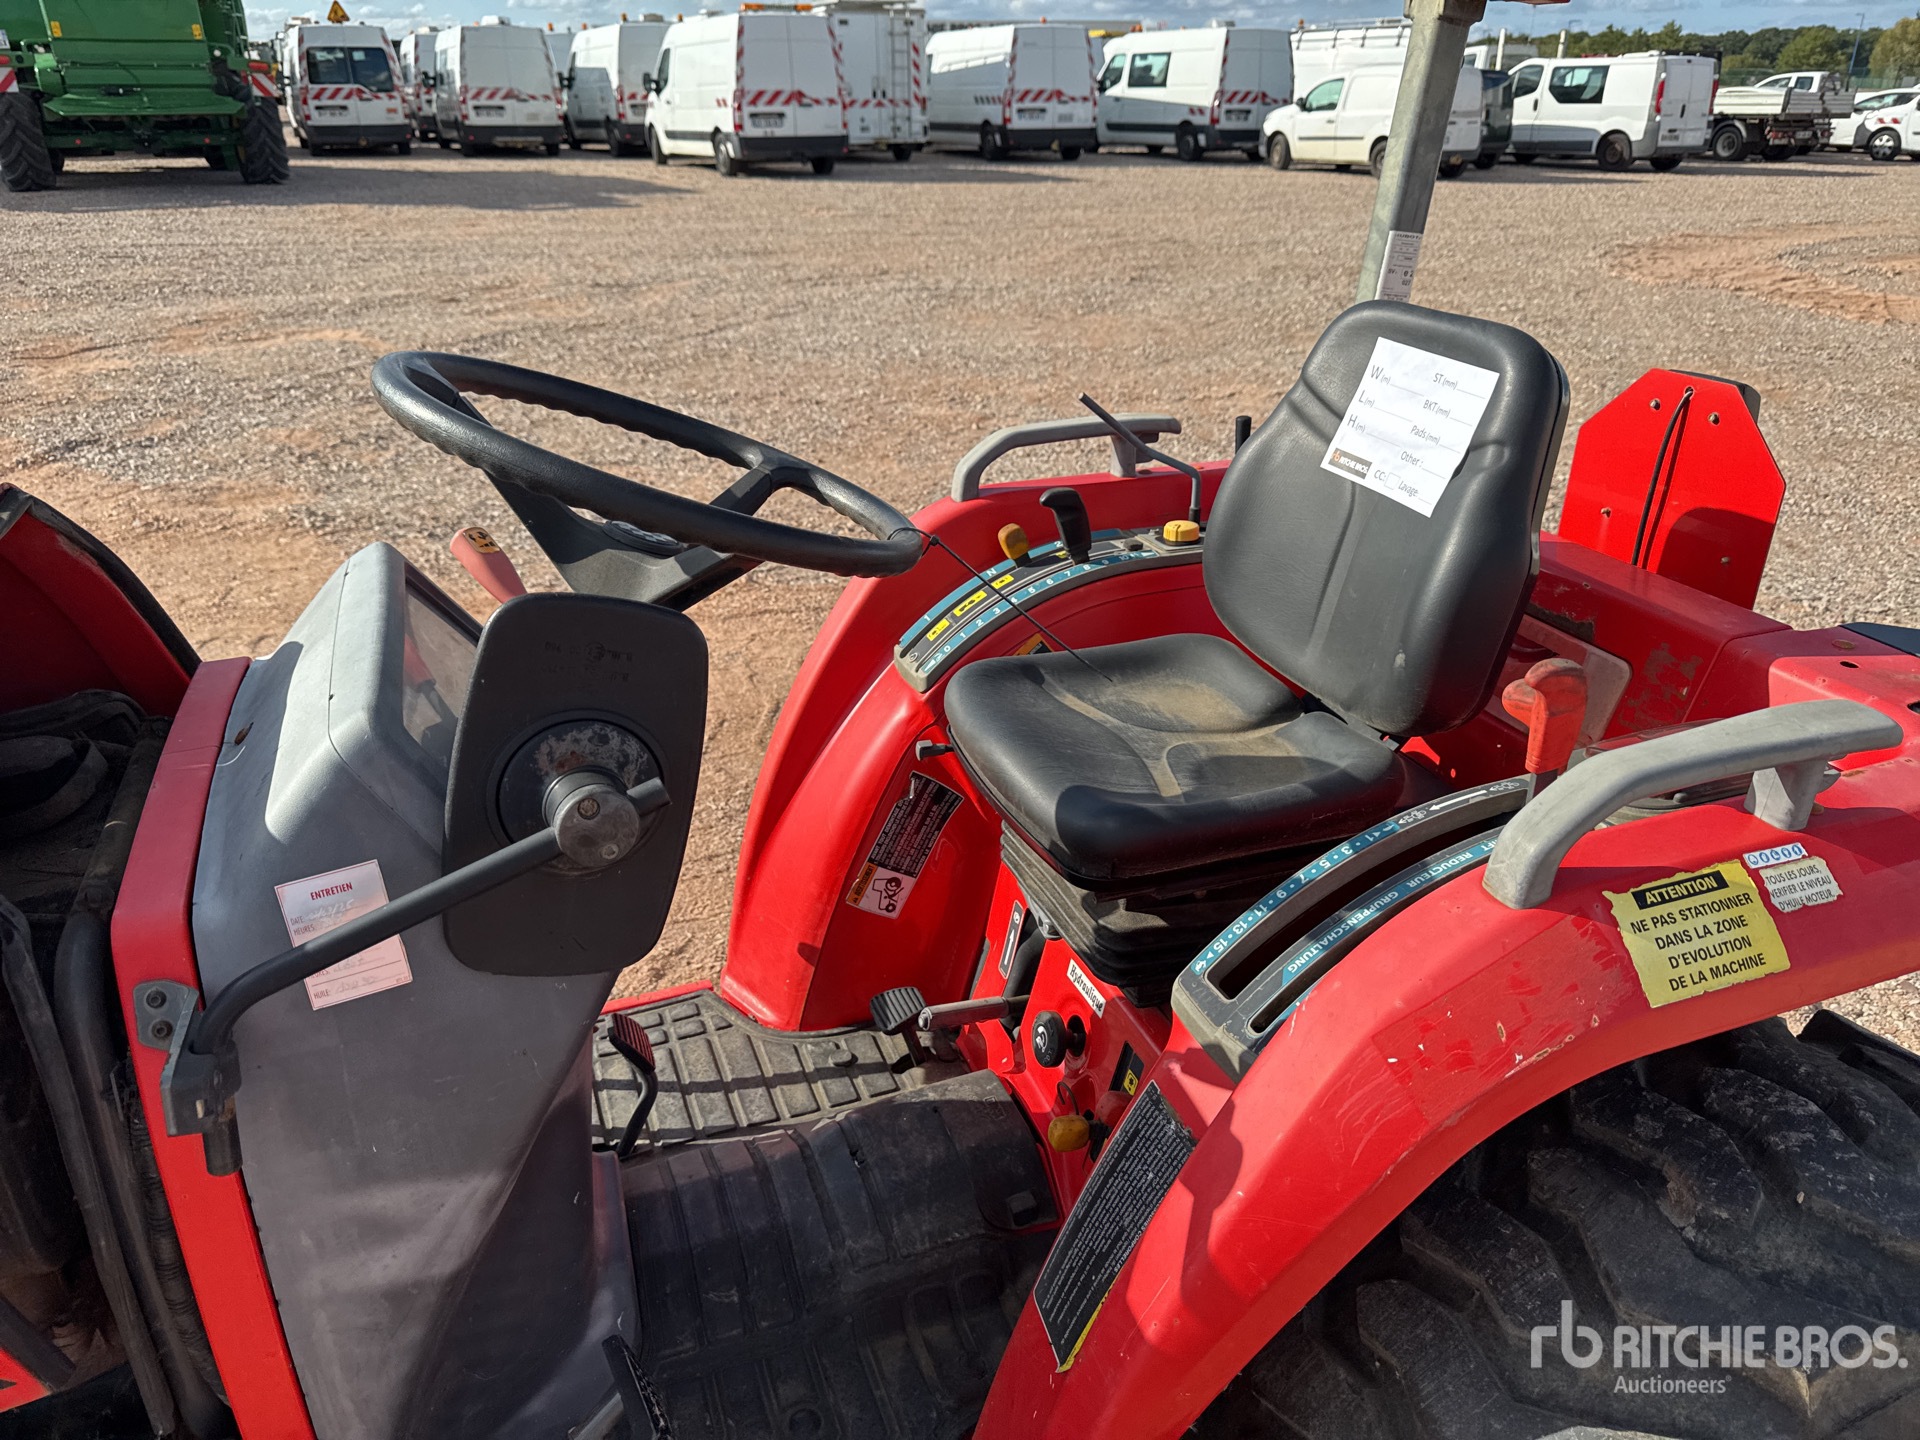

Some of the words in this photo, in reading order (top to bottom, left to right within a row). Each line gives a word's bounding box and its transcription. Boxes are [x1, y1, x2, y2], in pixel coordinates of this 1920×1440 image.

[1371, 365, 1384, 380] W
[986, 568, 996, 576] N
[1341, 846, 1352, 855] 3
[1319, 860, 1332, 868] 5
[1406, 852, 1474, 888] REDUCTEUR
[1300, 874, 1310, 884] 7
[1766, 873, 1786, 886] TOUS
[1784, 870, 1798, 881] LES
[1796, 864, 1822, 878] JOURS,
[310, 882, 352, 900] ENTRETIEN
[1276, 890, 1286, 898] 9
[1644, 876, 1718, 904] ATTENTION
[1770, 884, 1798, 899] VERIFIER
[1797, 882, 1806, 892] LE
[1804, 874, 1832, 890] NIVEAU
[1254, 904, 1268, 916] 11
[1778, 896, 1804, 910] D'HUILE
[1630, 918, 1650, 934] NE
[1651, 912, 1677, 929] PAS
[1680, 892, 1753, 921] STATIONNER
[1232, 920, 1248, 934] 13
[1288, 891, 1398, 973] GRUPPENSCHALTUNG
[1654, 929, 1693, 950] DANS
[1695, 924, 1714, 938] LA
[1713, 914, 1748, 934] ZONE
[1213, 938, 1228, 953] 15
[1668, 935, 1752, 969] D'EVOLUTION
[1668, 976, 1688, 992] DE
[1690, 970, 1708, 985] LA
[1709, 953, 1766, 979] MACHINE
[1070, 964, 1104, 1013] Hydraulique
